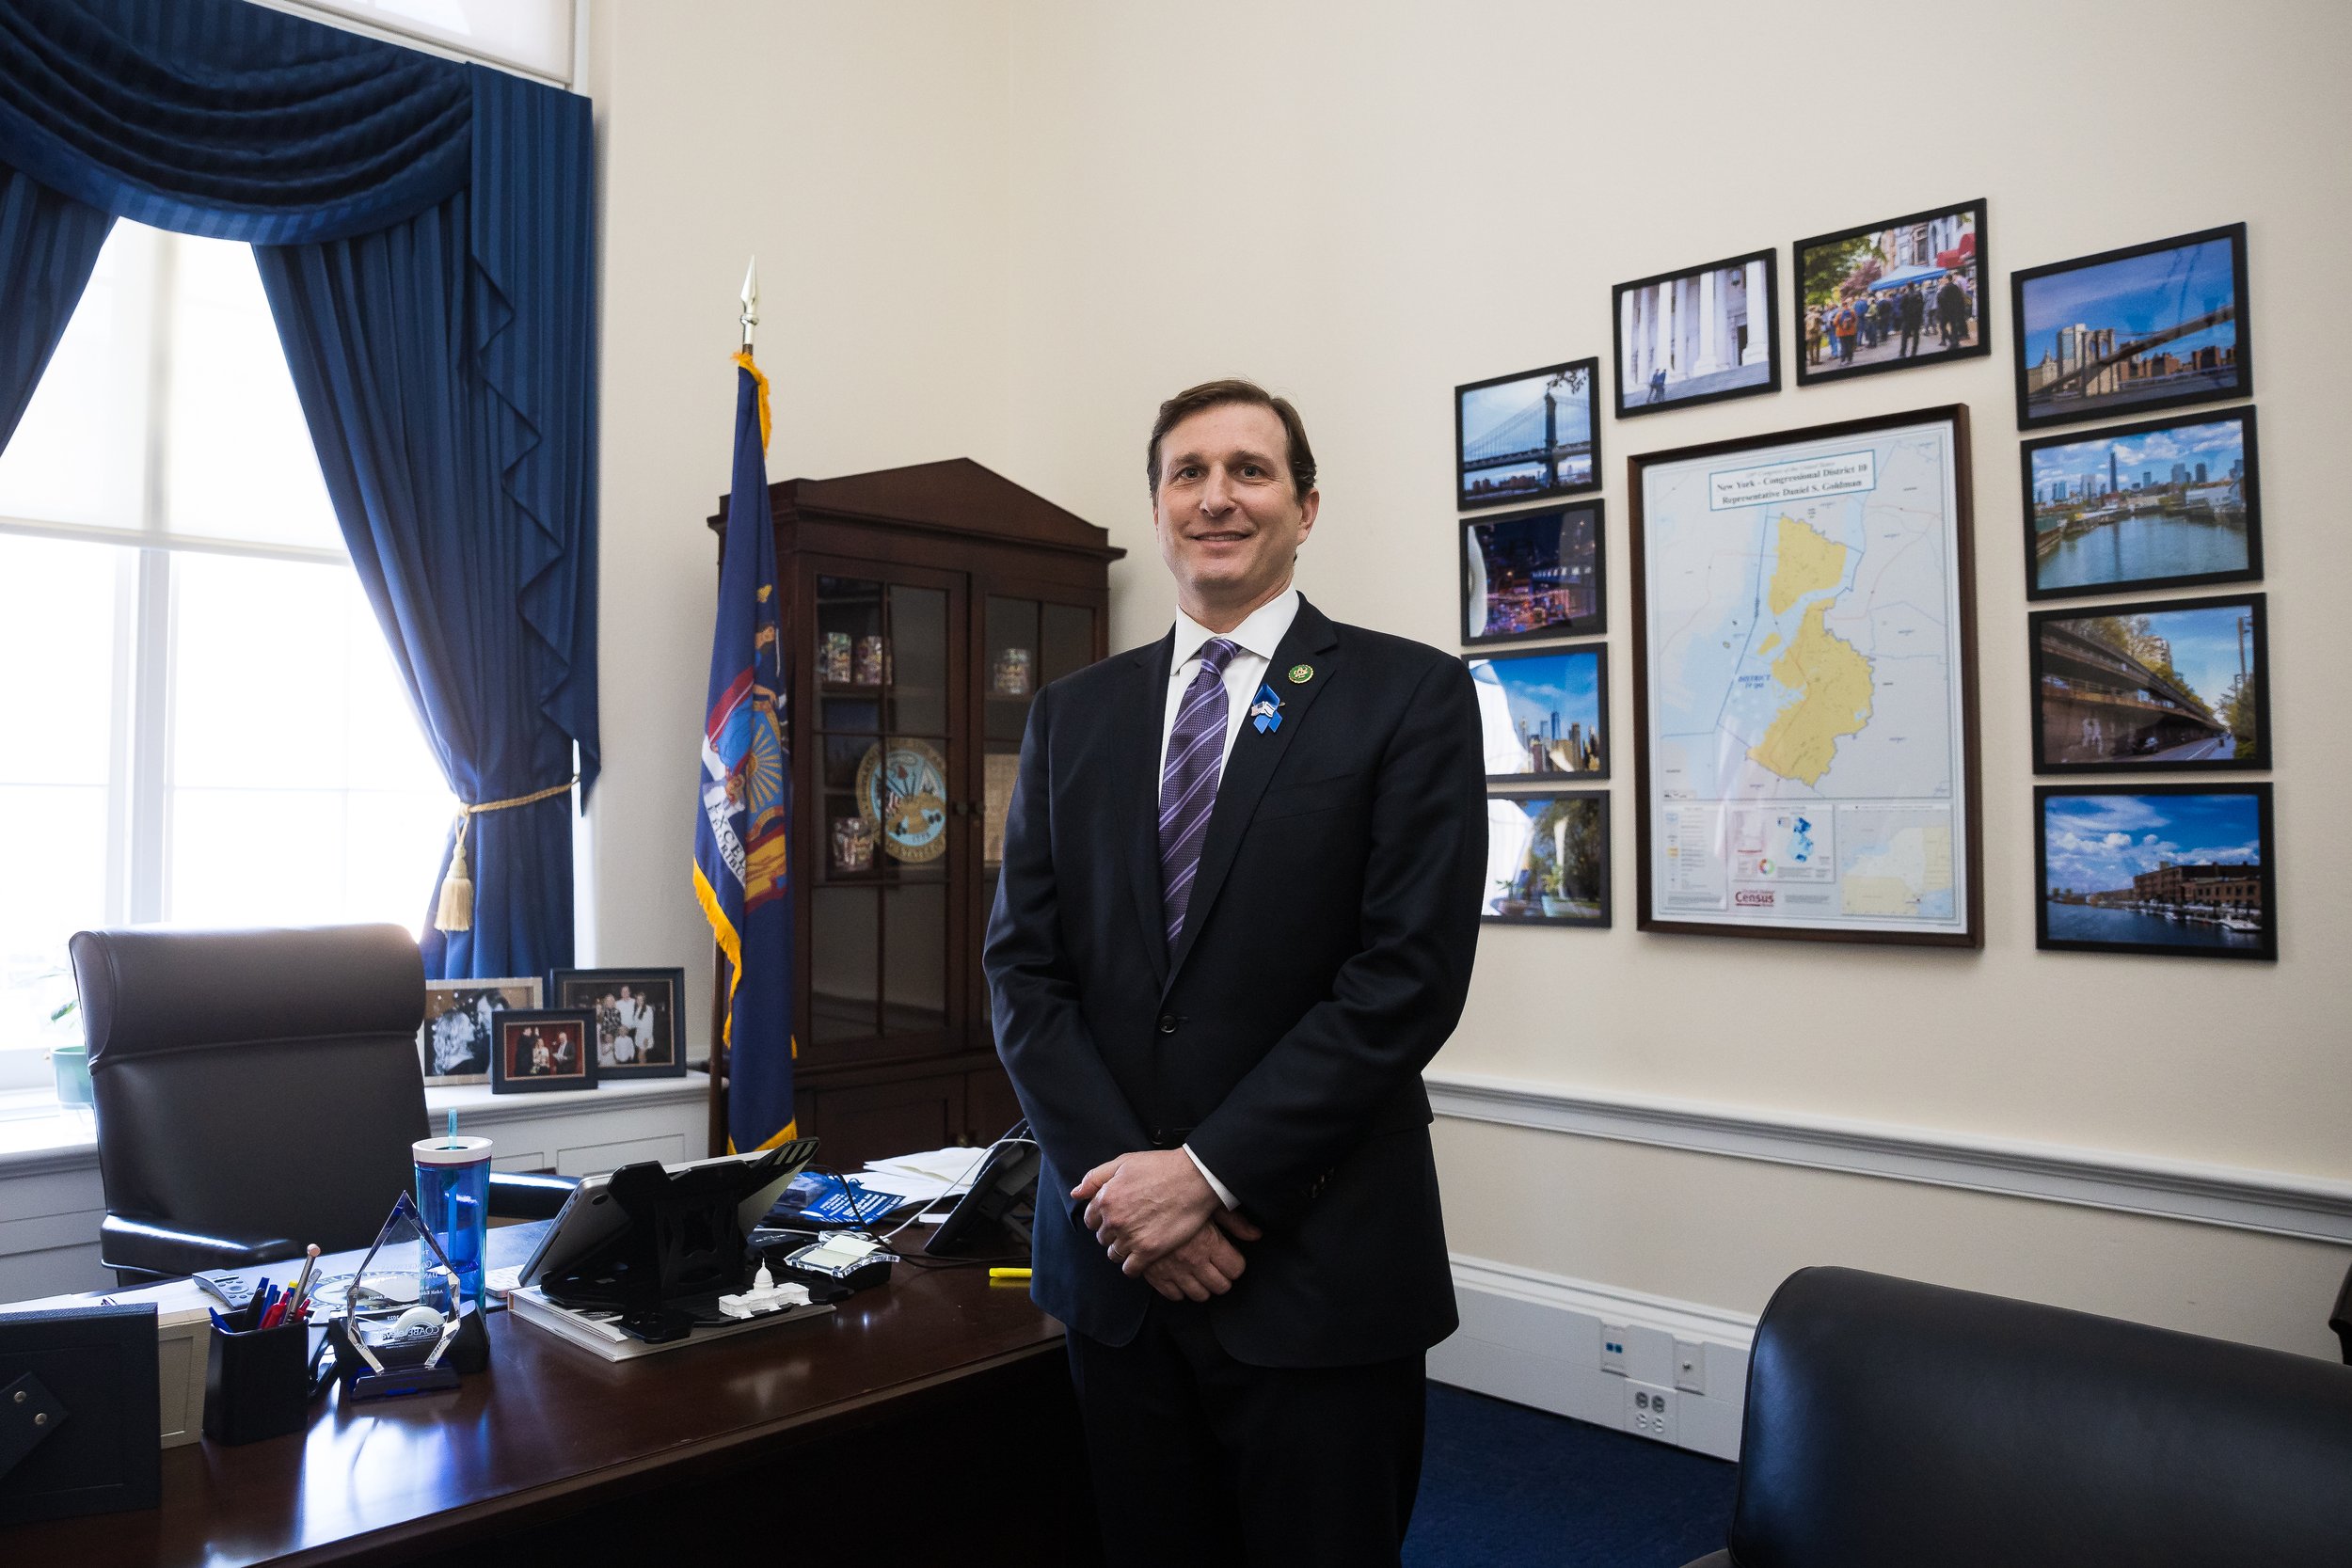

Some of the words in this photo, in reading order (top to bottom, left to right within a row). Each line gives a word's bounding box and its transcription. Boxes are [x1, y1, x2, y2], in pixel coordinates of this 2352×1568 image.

[1762, 470, 1820, 485] Congressional
[1822, 466, 1855, 477] District
[1722, 491, 1780, 505] Representative
[1782, 485, 1810, 496] Daniel
[1821, 480, 1863, 491] Goldman
[1735, 891, 1774, 903] Census
